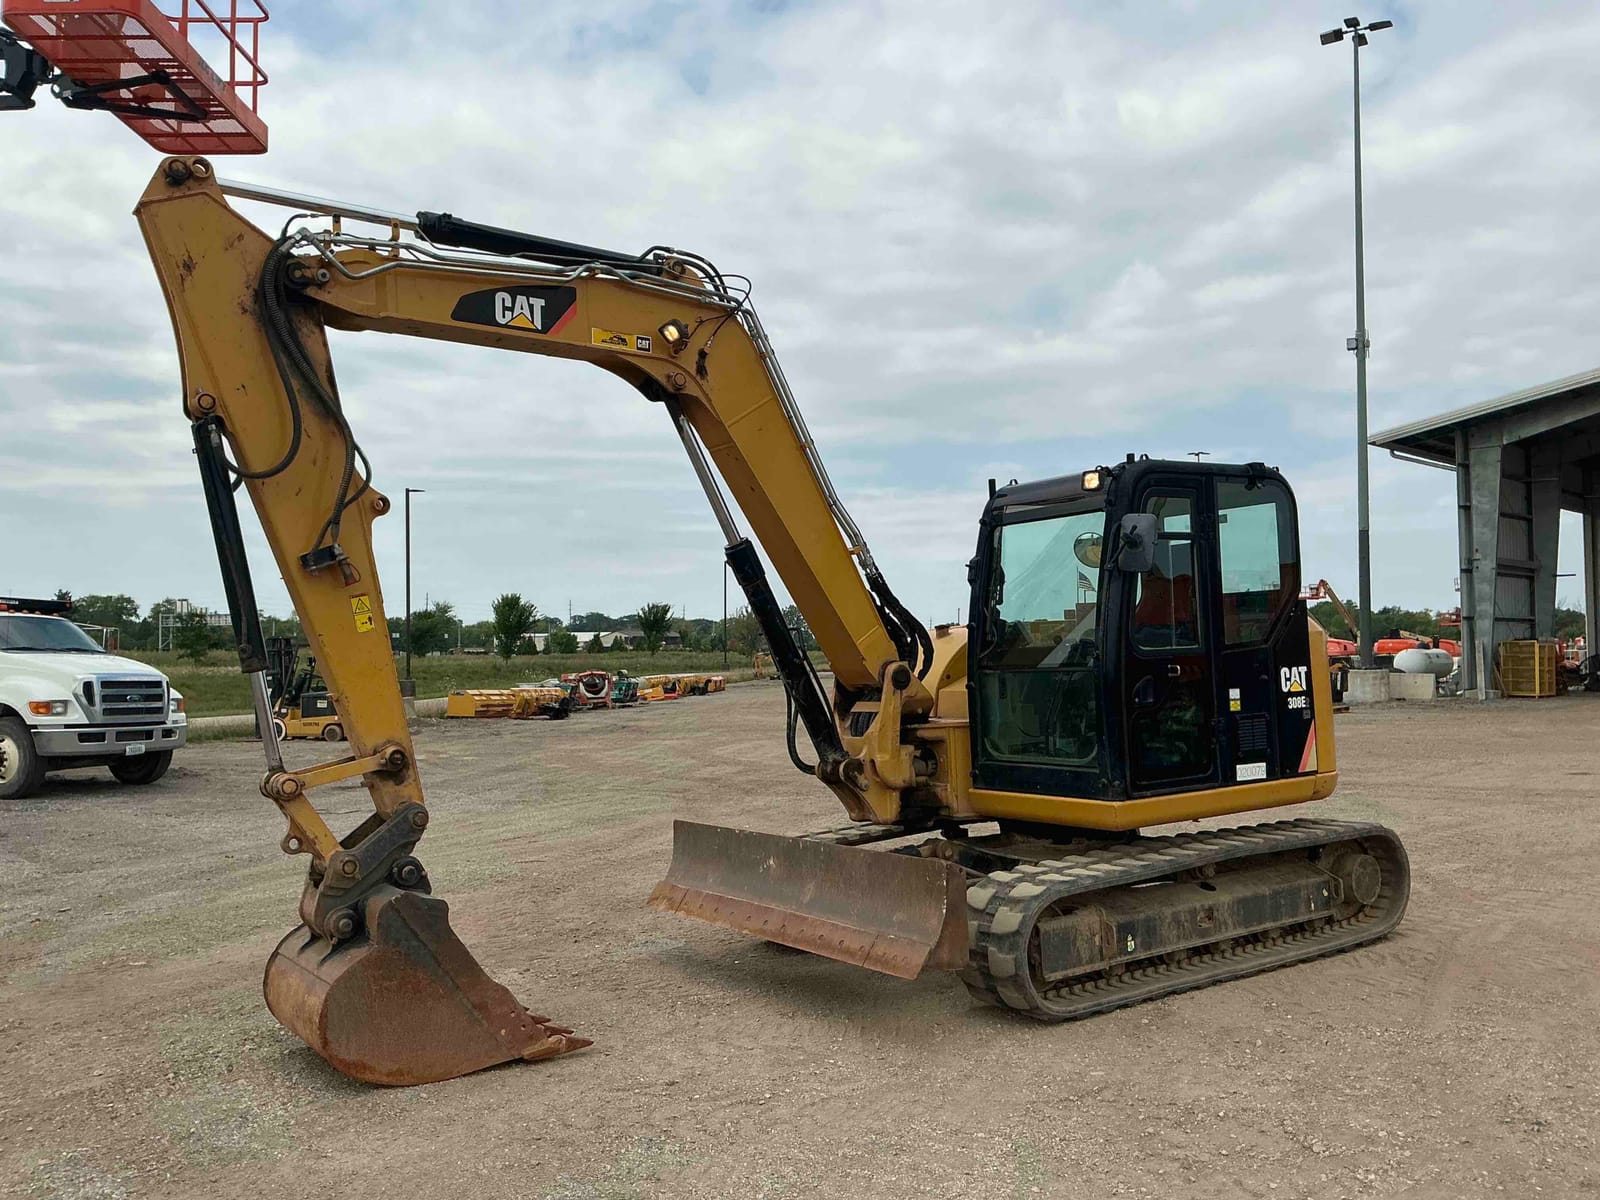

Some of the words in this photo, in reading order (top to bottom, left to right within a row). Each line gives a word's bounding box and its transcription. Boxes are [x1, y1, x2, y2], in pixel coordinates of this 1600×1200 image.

[494, 291, 546, 331] CAT
[637, 338, 650, 349] CAT
[1280, 666, 1308, 692] CAT
